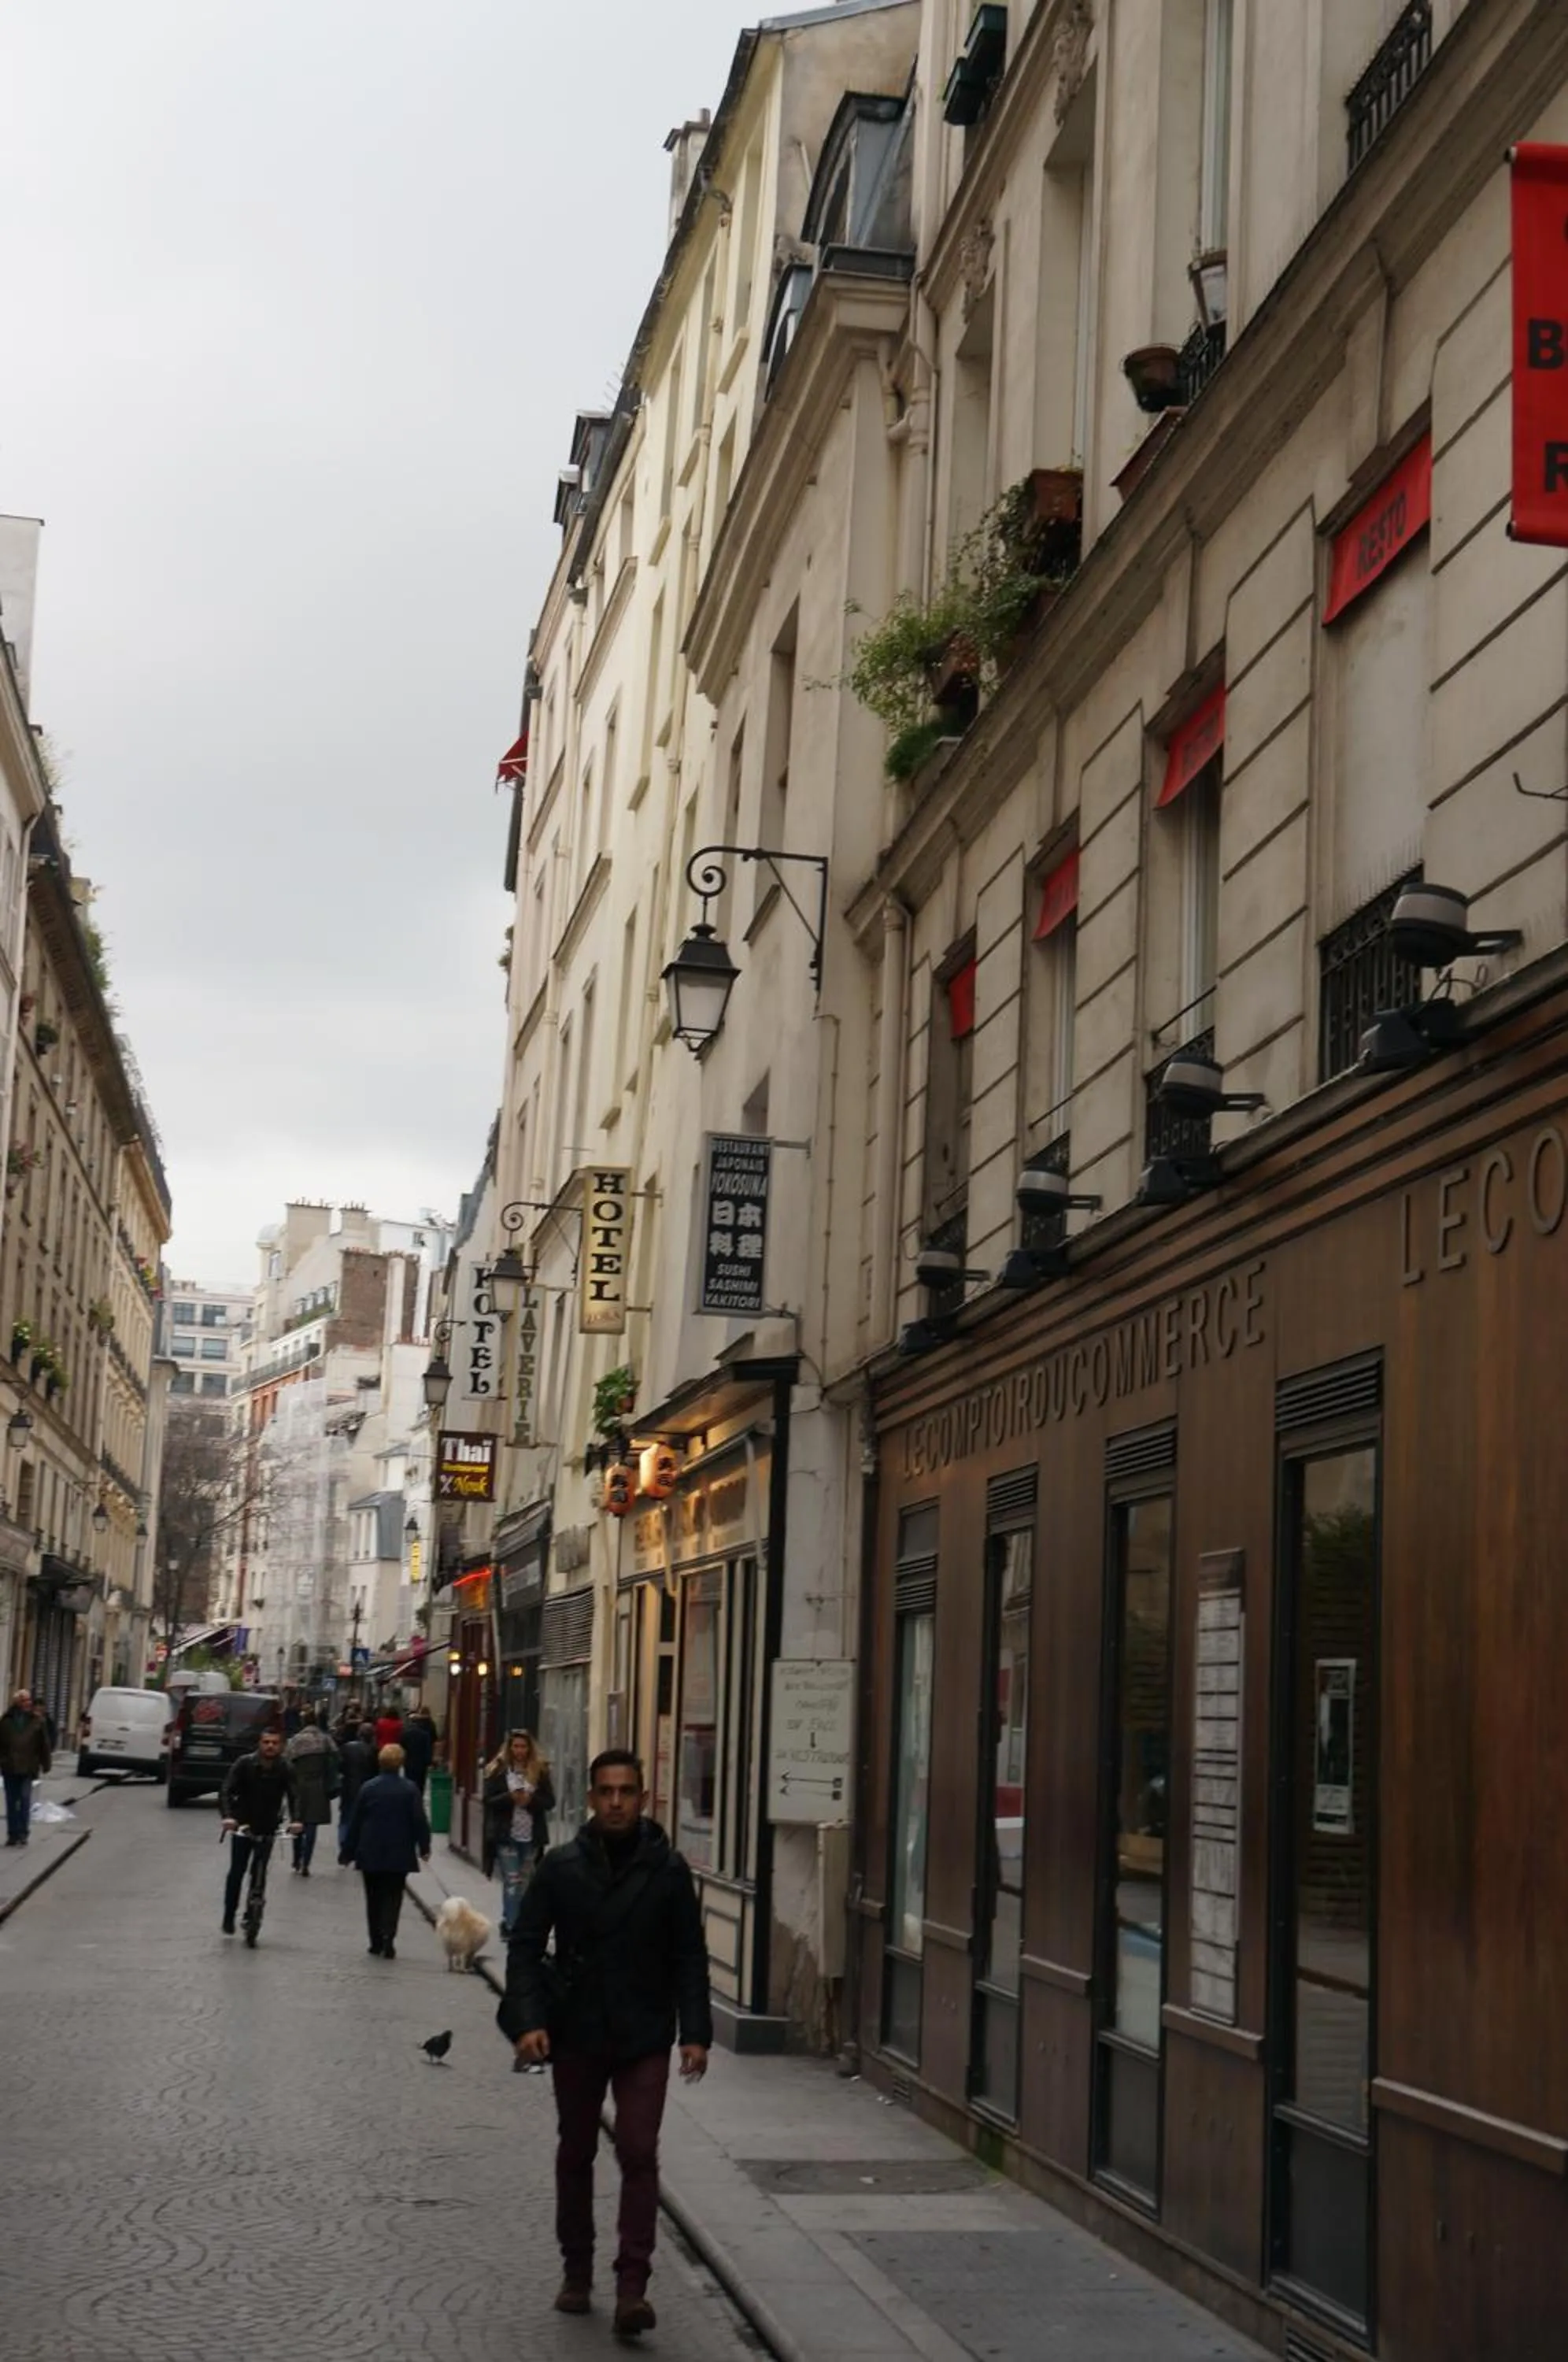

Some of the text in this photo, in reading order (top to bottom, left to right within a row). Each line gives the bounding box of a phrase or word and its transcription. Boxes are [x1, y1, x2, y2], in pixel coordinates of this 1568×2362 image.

[1356, 489, 1407, 582] RESTO
[716, 1156, 764, 1172] JAPONAIS
[712, 1199, 763, 1227] 日本
[589, 1172, 625, 1302] HOTEL
[710, 1231, 763, 1259] 料理
[717, 1263, 752, 1276] SUSHI
[708, 1278, 759, 1294] SASHIMI
[705, 1294, 760, 1309] YAKITORI
[514, 1287, 538, 1446] LAVERIE
